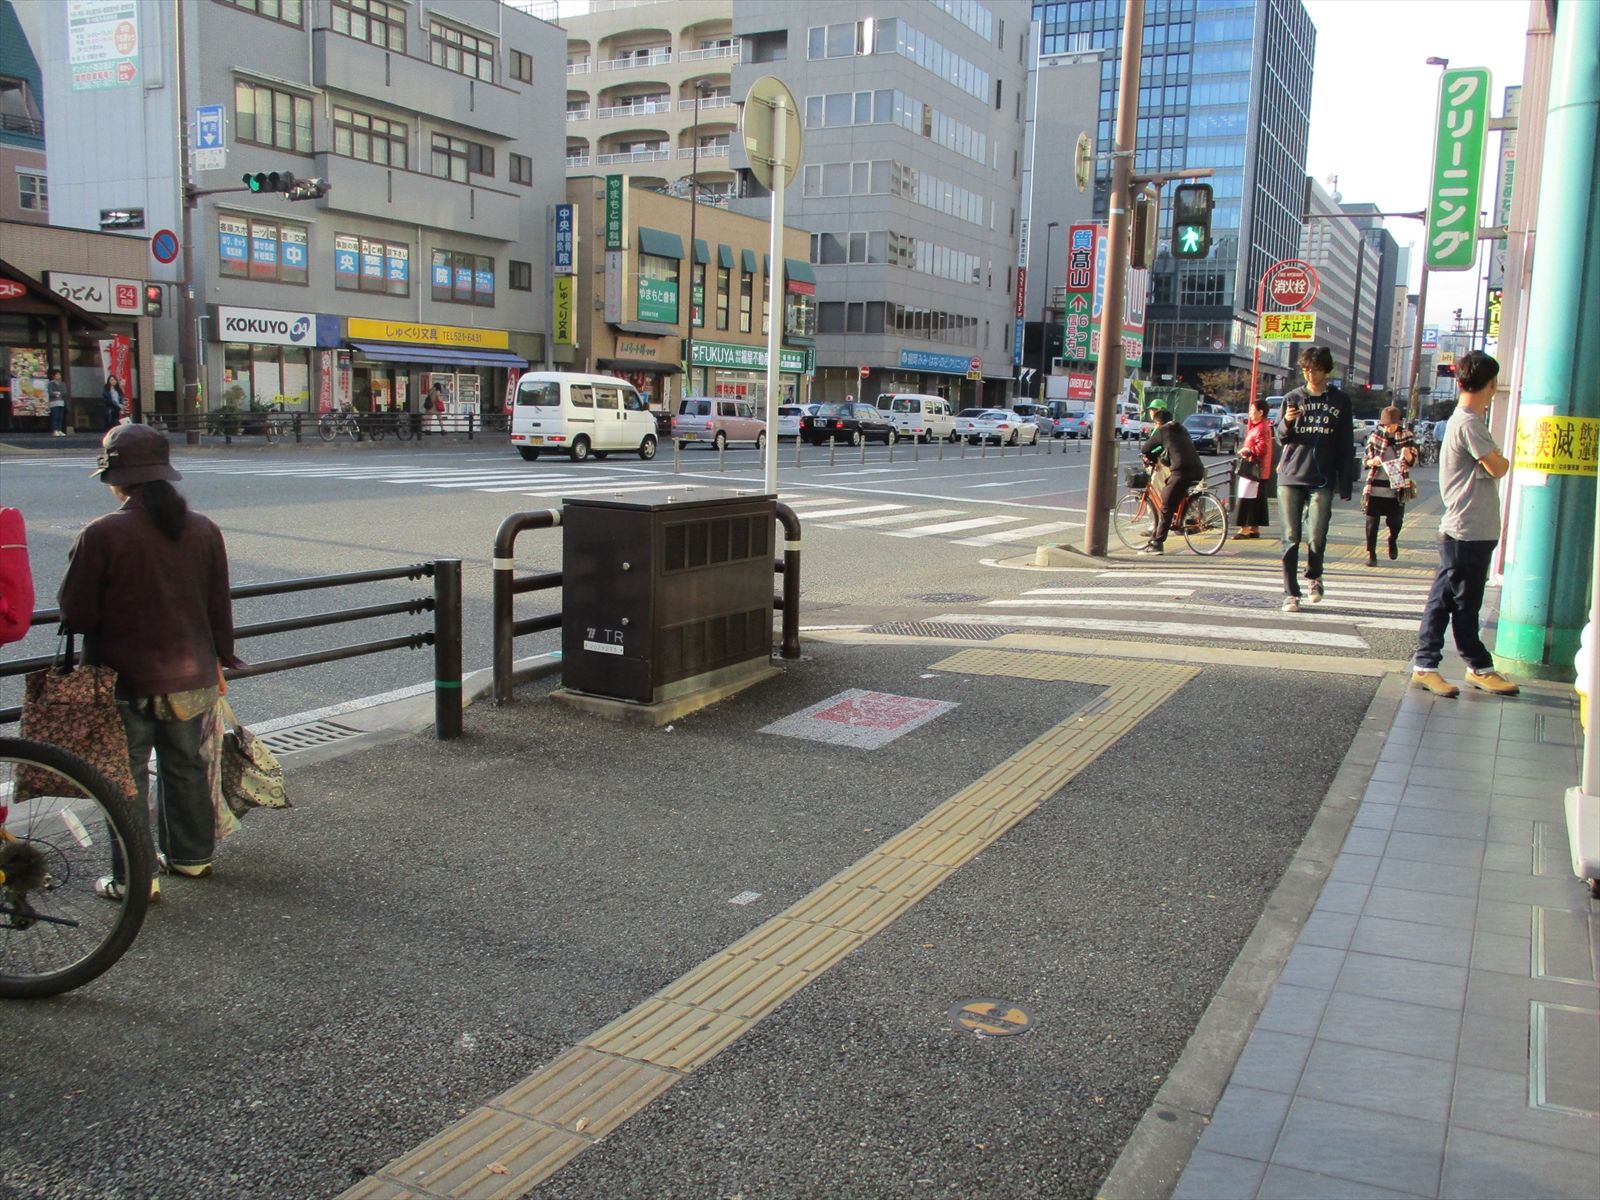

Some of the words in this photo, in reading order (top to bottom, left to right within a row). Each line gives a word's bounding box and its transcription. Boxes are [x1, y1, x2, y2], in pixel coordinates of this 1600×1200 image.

[1432, 76, 1479, 260] クリーニング
[610, 179, 620, 241] やまもと歯科
[59, 281, 102, 301] うどん
[119, 287, 134, 298] 24
[1274, 279, 1307, 294] 消火栓
[640, 288, 676, 304] やまもと歯科
[558, 281, 568, 340] しゅくり文具
[226, 317, 288, 335] KOKUYO
[386, 325, 438, 341] しゅくり文具
[1264, 315, 1281, 333] 質
[1281, 321, 1313, 332] 大江戸
[699, 345, 735, 363] FUKUYA
[1303, 416, 1330, 424] 1920
[603, 628, 624, 644] TR
